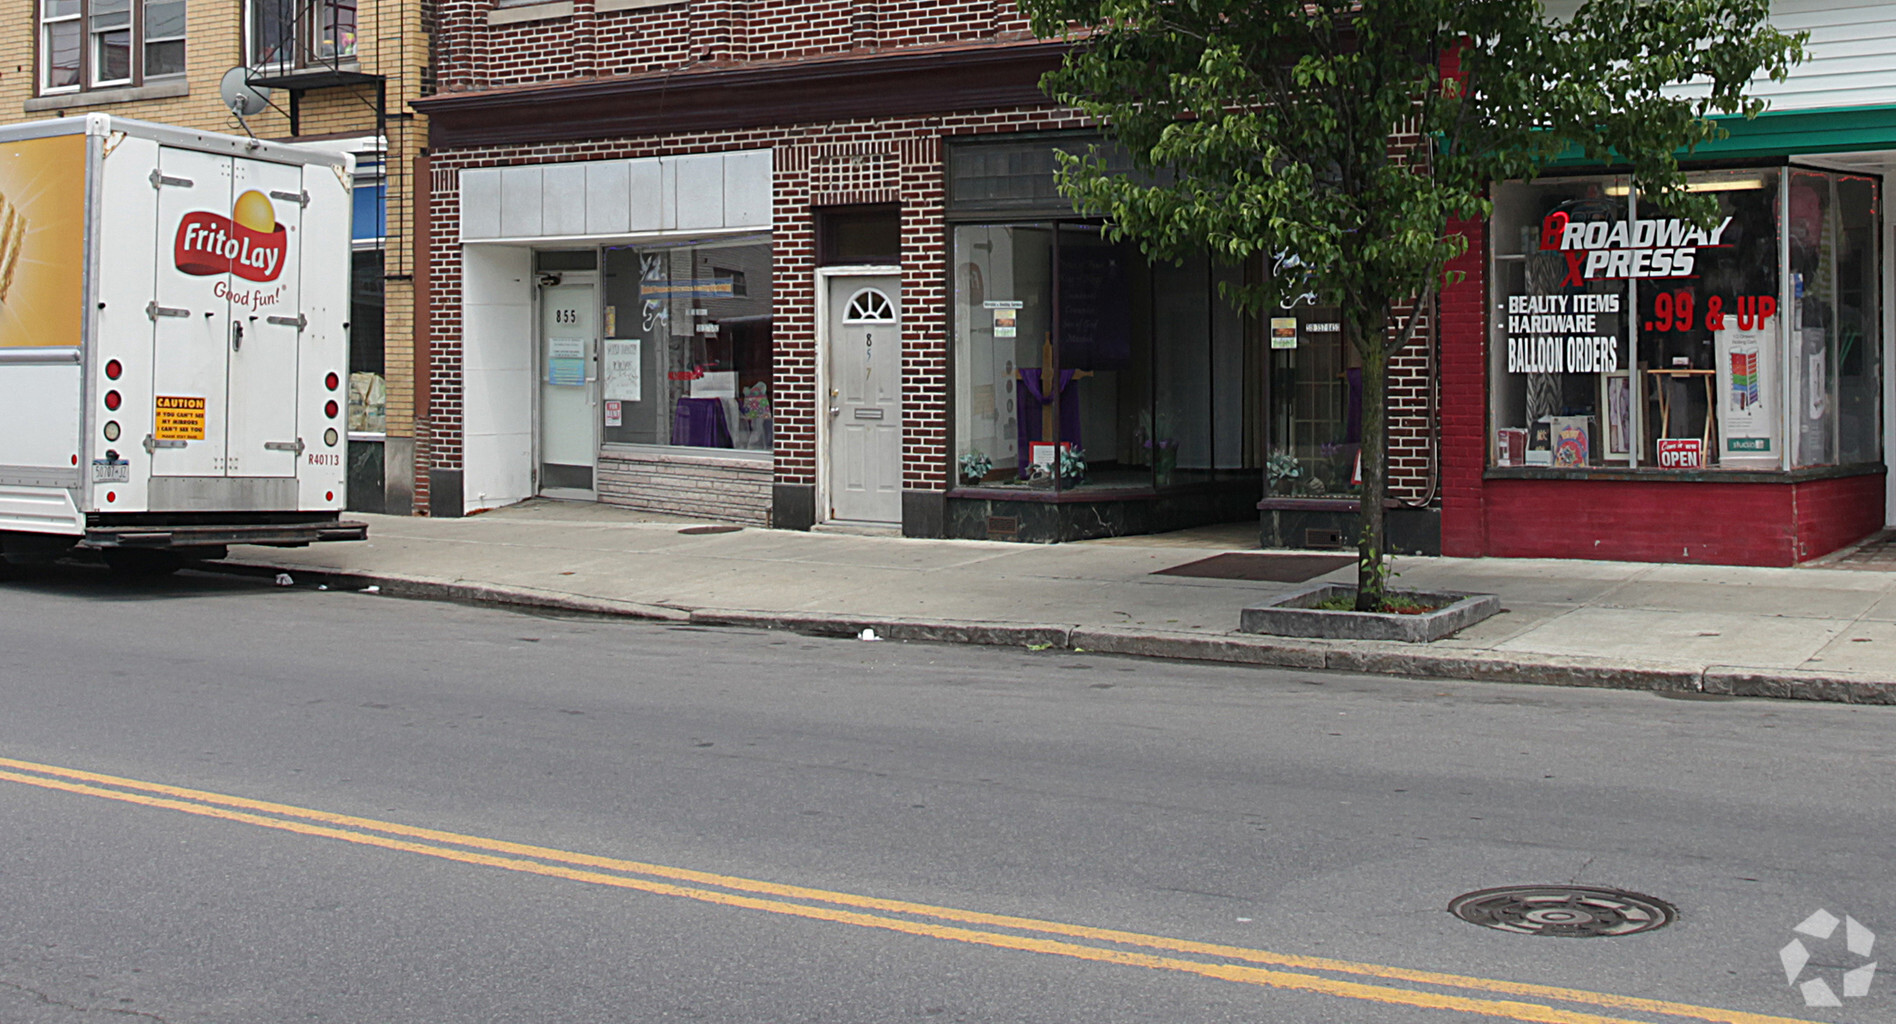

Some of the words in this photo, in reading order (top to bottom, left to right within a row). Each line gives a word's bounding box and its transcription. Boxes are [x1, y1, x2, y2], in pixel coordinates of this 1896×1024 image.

[1539, 211, 1733, 251] BROADWAY
[1560, 247, 1697, 287] XPRESS
[214, 281, 249, 306] Good
[251, 287, 280, 312] fun!
[1508, 295, 1569, 314] BEAUTY
[1573, 294, 1620, 313] ITEMS
[556, 309, 576, 324] 855
[1644, 292, 1694, 332] .99
[1705, 295, 1726, 332] &
[1737, 295, 1777, 331] UP
[1508, 314, 1597, 334] HARDWARE
[1508, 337, 1563, 373] BALLOON
[1566, 336, 1618, 373] ORDERS
[157, 398, 204, 409] CAUTION
[308, 453, 340, 466] R40113
[1661, 451, 1698, 467] OPEN
